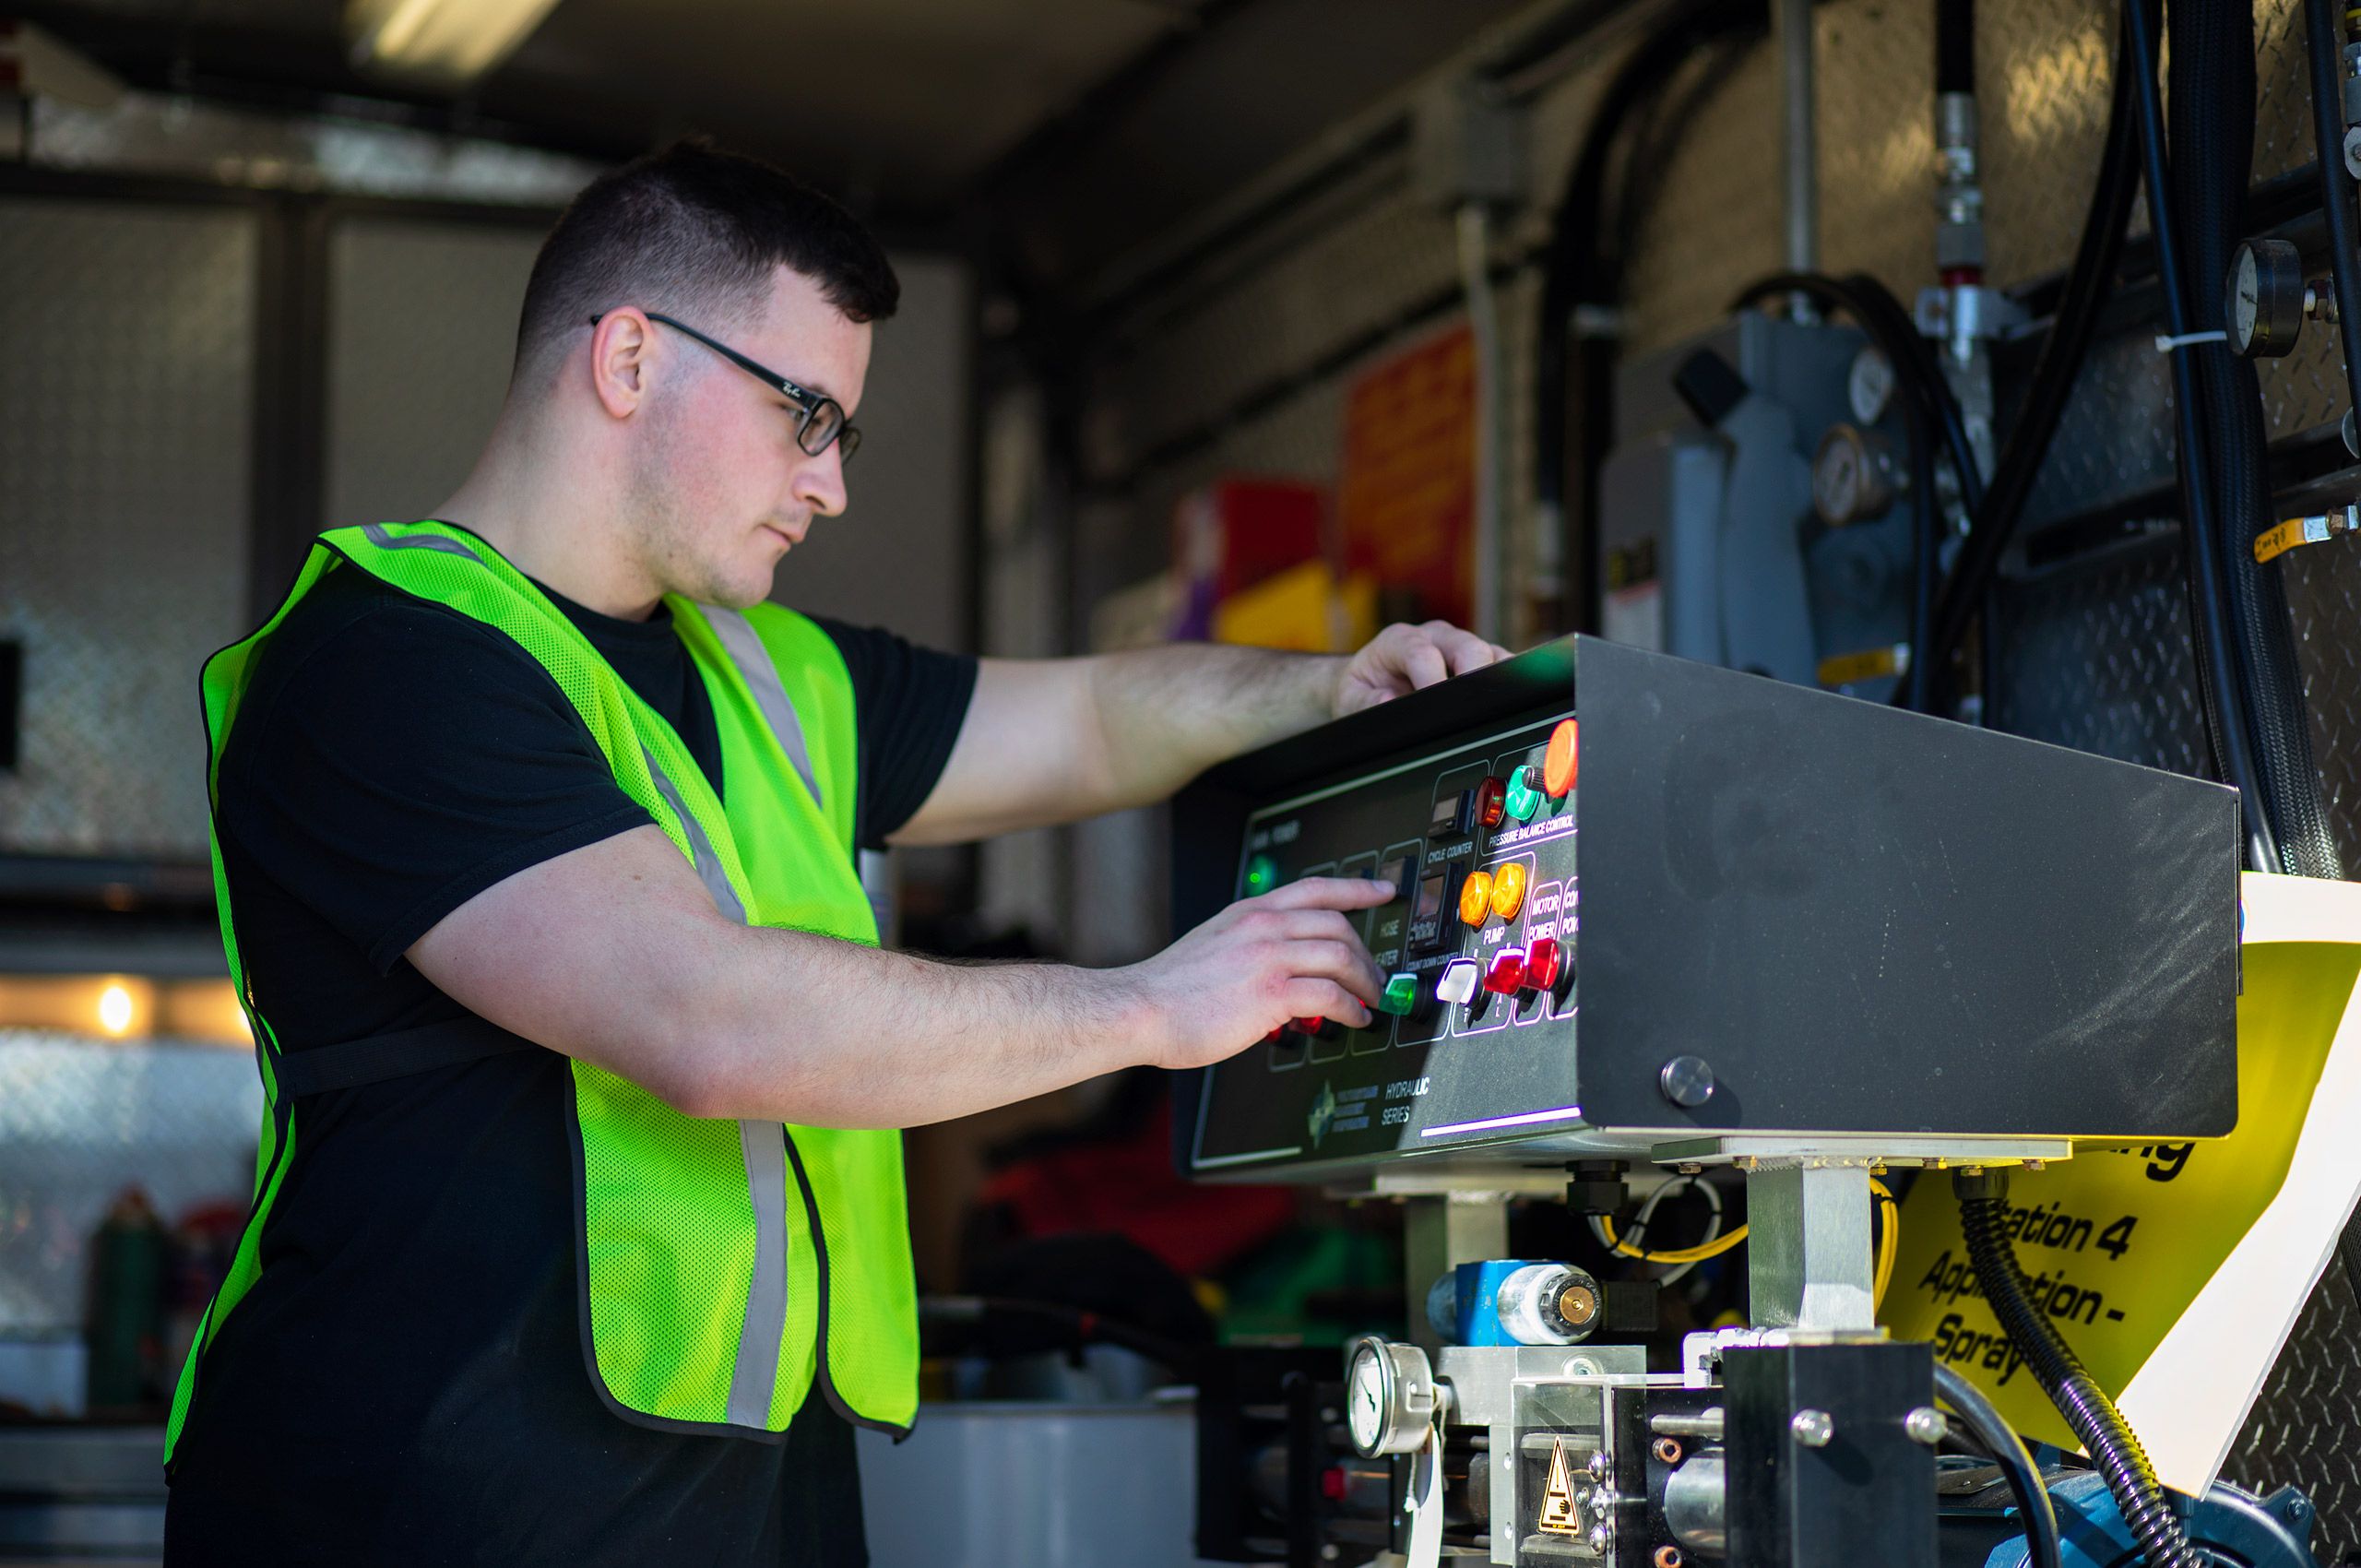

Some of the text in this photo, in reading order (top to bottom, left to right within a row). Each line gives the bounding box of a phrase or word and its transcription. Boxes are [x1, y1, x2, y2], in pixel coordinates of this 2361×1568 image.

[1489, 814, 1573, 848] PRESSURE BALANCE CONTROL
[1428, 841, 1473, 863] CYCLE COUNTER
[1532, 894, 1560, 916] MOTOR
[1483, 925, 1505, 944] PUMP
[1528, 921, 1556, 941] POWER
[1561, 916, 1579, 934] POW
[1374, 949, 1399, 967] EATER
[1385, 1076, 1430, 1099] HYDRAULIC
[1382, 1106, 1410, 1125] SERIES
[2095, 1215, 2139, 1262] 4
[1934, 1313, 2025, 1386] Spray
